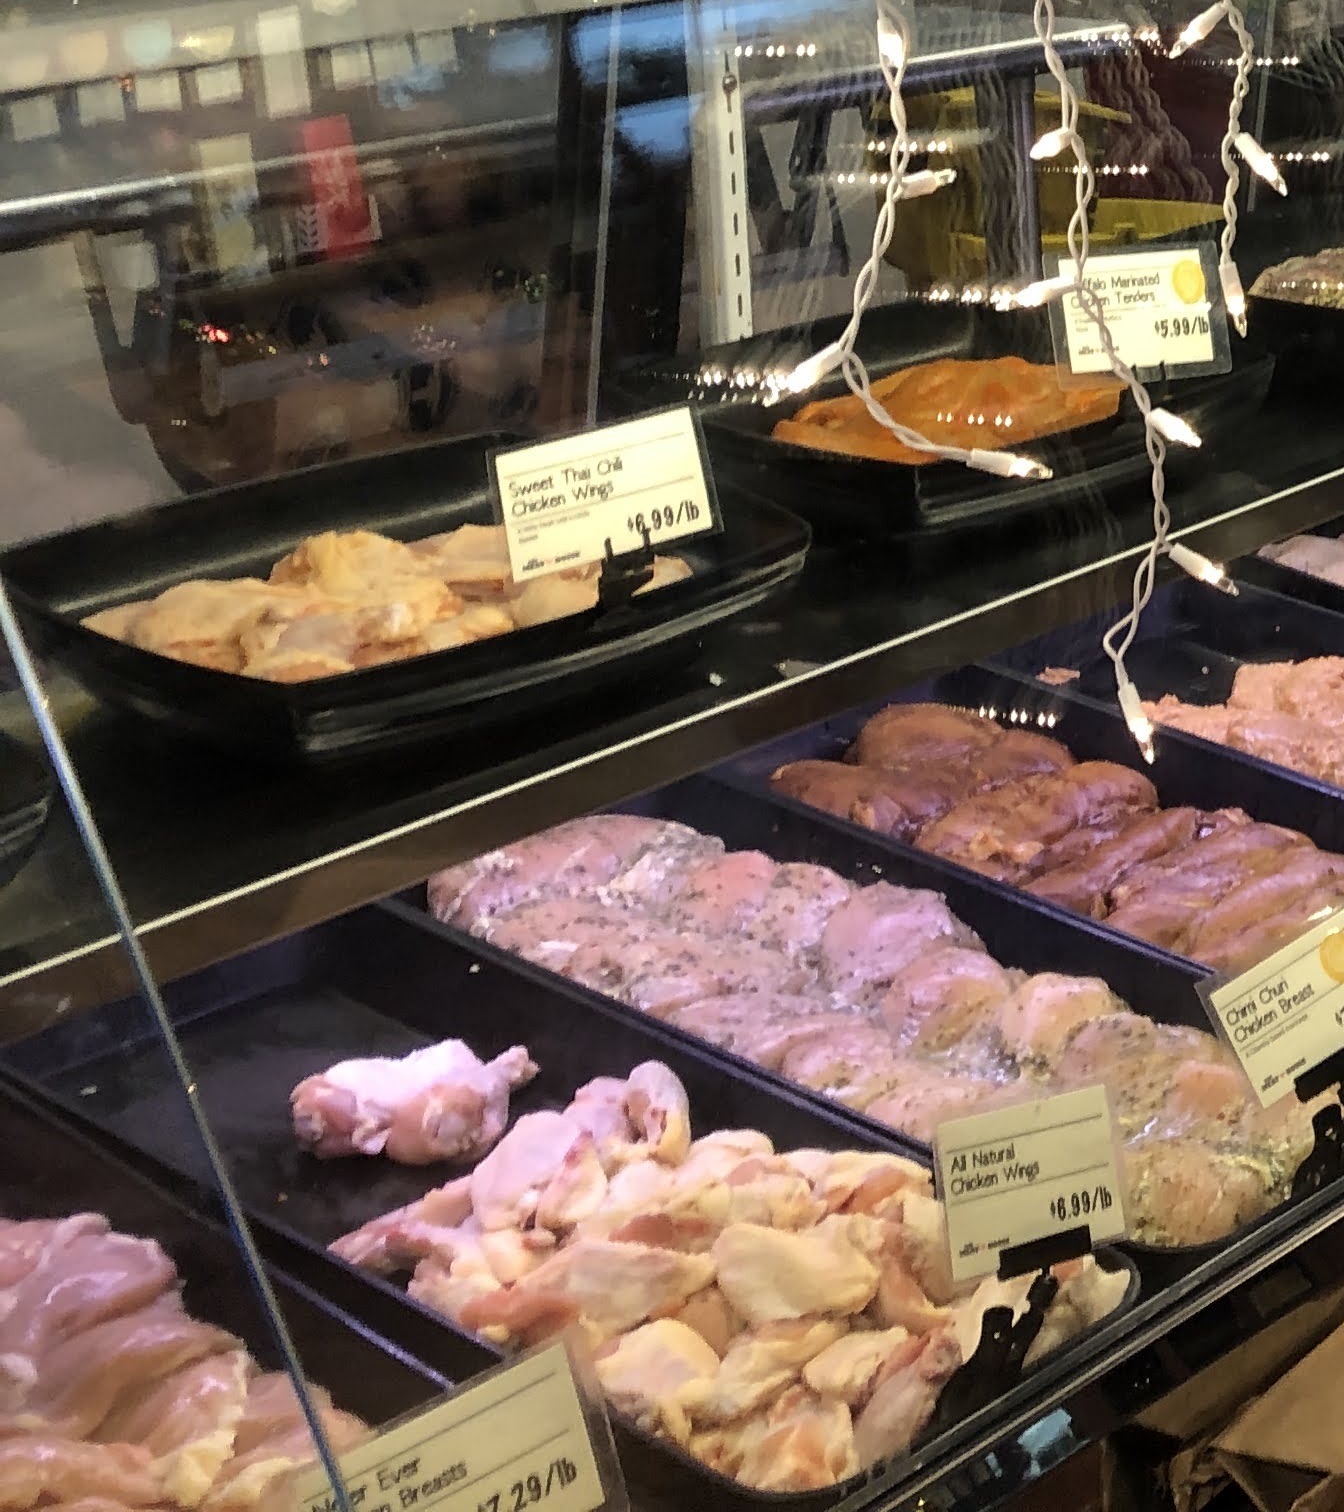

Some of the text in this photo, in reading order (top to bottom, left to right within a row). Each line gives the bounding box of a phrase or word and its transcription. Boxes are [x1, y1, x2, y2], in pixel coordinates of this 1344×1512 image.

[1111, 272, 1160, 288] Marinated
[1117, 290, 1155, 305] Tenders
[1155, 317, 1209, 338] $5.99/lb
[508, 455, 624, 498] Sweet Thai Chili
[511, 480, 615, 518] Chicken Wings
[627, 500, 700, 534] $6.99/lb
[1233, 1009, 1278, 1043] Chicken
[1278, 983, 1316, 1014] Breast
[950, 1143, 1016, 1175] All Natural
[950, 1161, 1040, 1196] Chicken Wings
[1050, 1185, 1113, 1221] $6.99/lb
[376, 1458, 421, 1492] Ever
